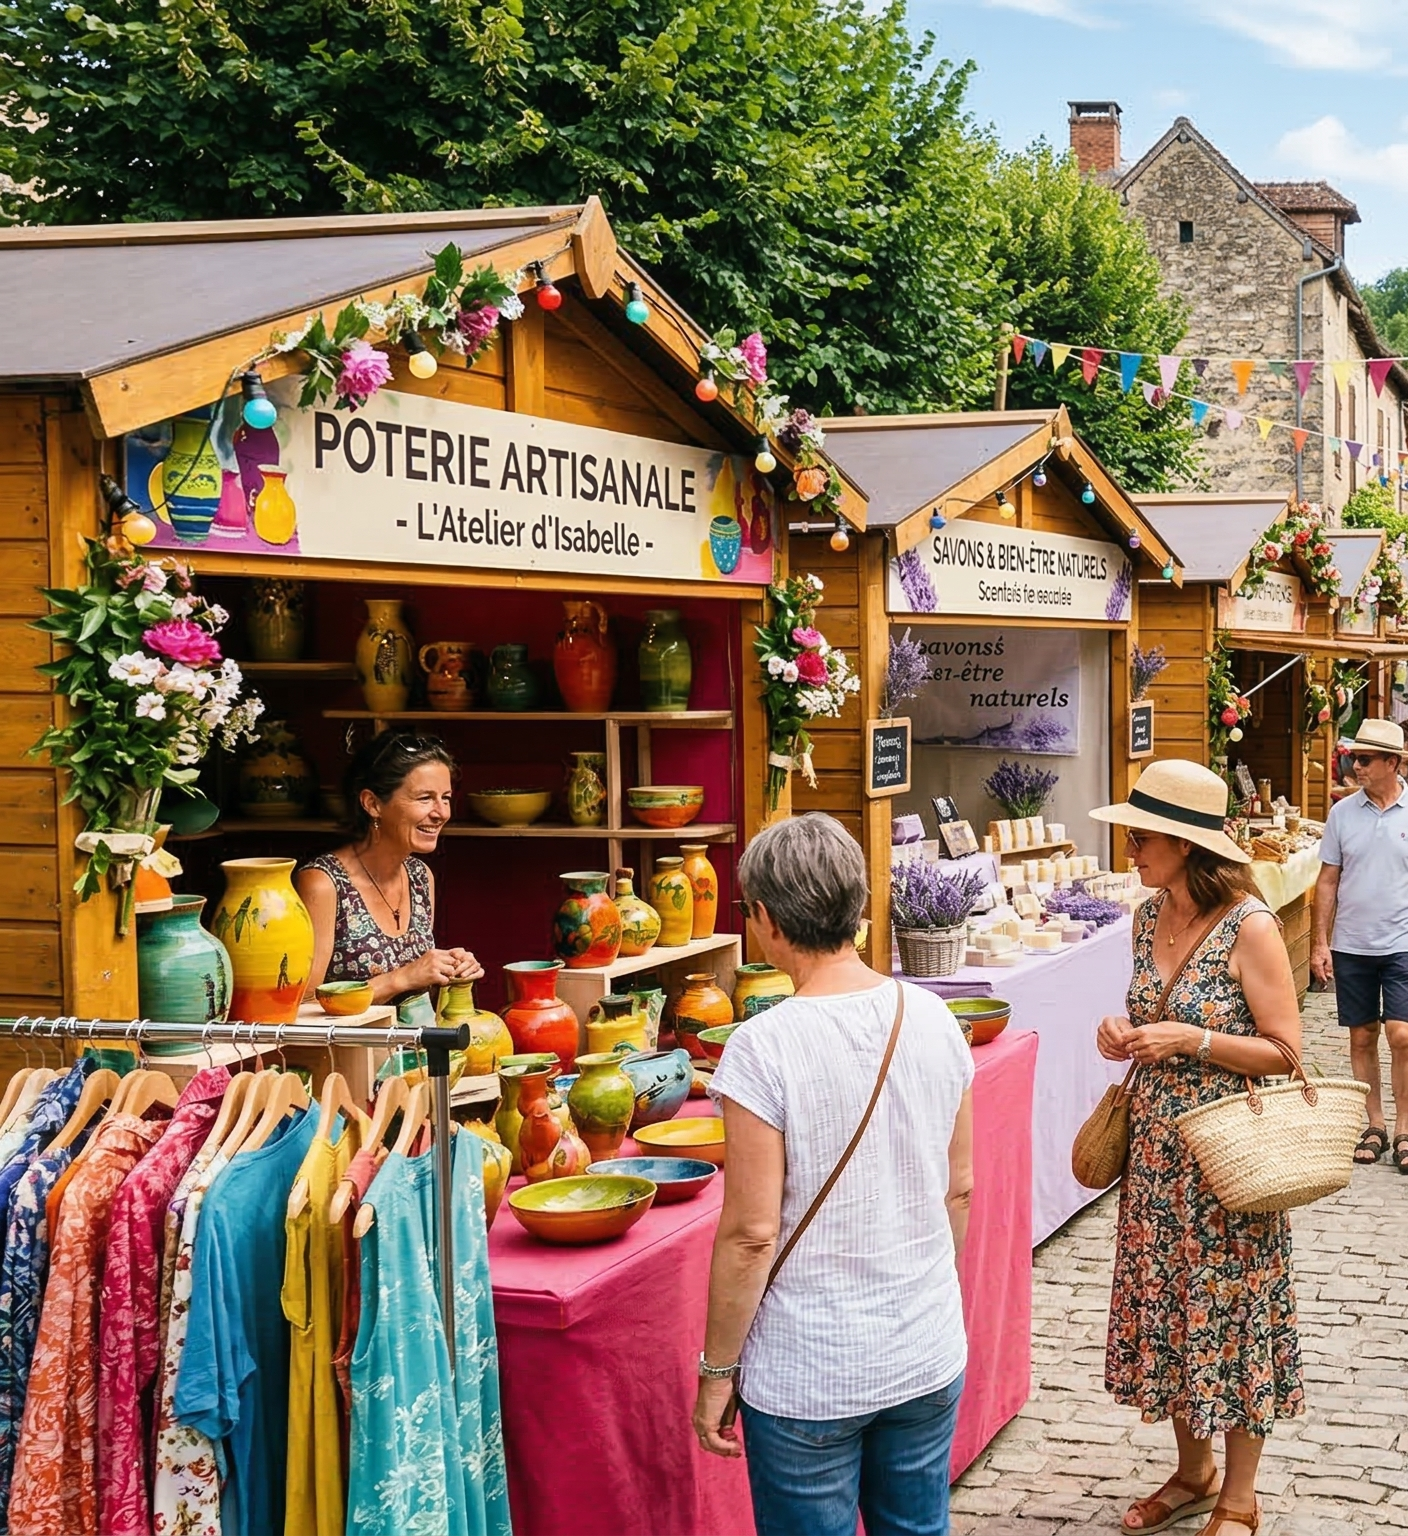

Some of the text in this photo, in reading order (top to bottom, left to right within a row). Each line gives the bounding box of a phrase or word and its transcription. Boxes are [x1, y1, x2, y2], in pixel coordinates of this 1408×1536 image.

[314, 411, 696, 514] POTERIE ARTISANALE
[417, 502, 525, 547] L'Atelier
[532, 514, 640, 557] d'Isabelle
[933, 536, 1107, 581] SAVONS & BIEN-ÊTRE NATURELS
[970, 687, 1069, 708] naturels
